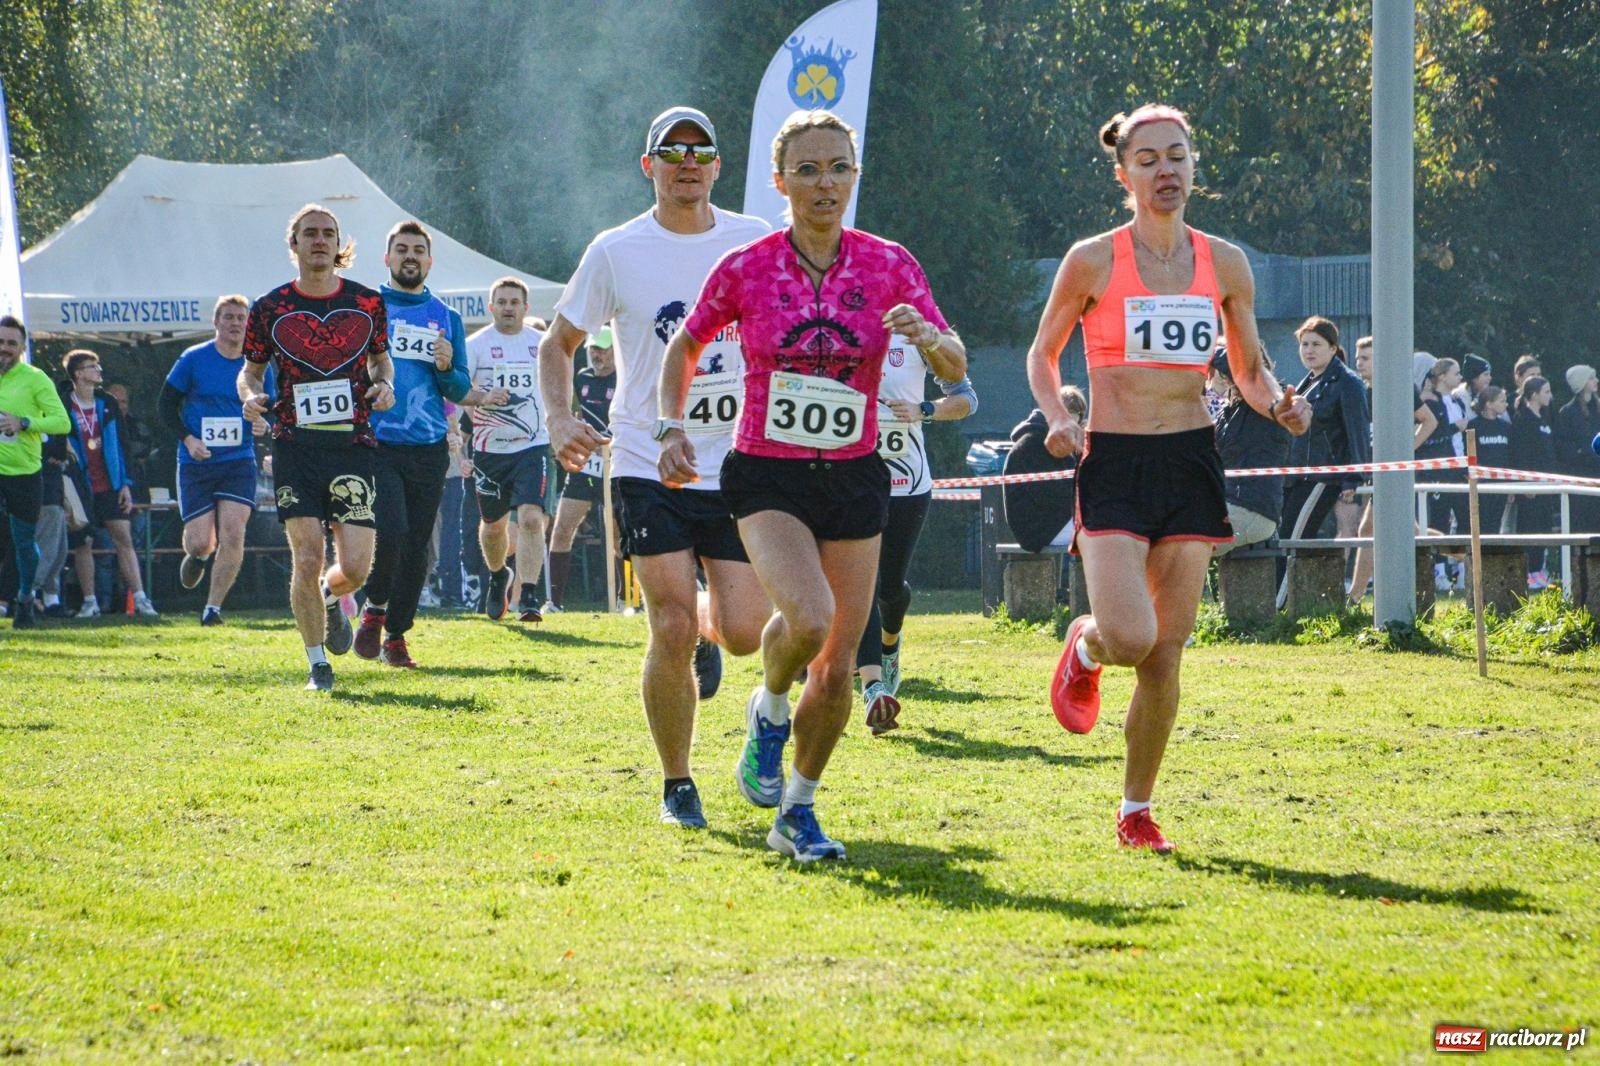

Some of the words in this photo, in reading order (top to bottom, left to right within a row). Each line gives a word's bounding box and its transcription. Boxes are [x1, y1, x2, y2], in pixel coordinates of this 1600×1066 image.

[61, 300, 200, 323] STOWARZYSZENIE
[1134, 320, 1212, 352] 196
[496, 374, 532, 388] 183
[300, 394, 349, 417] 150
[689, 394, 738, 424] 40
[772, 398, 857, 438] 309
[205, 428, 239, 441] 341
